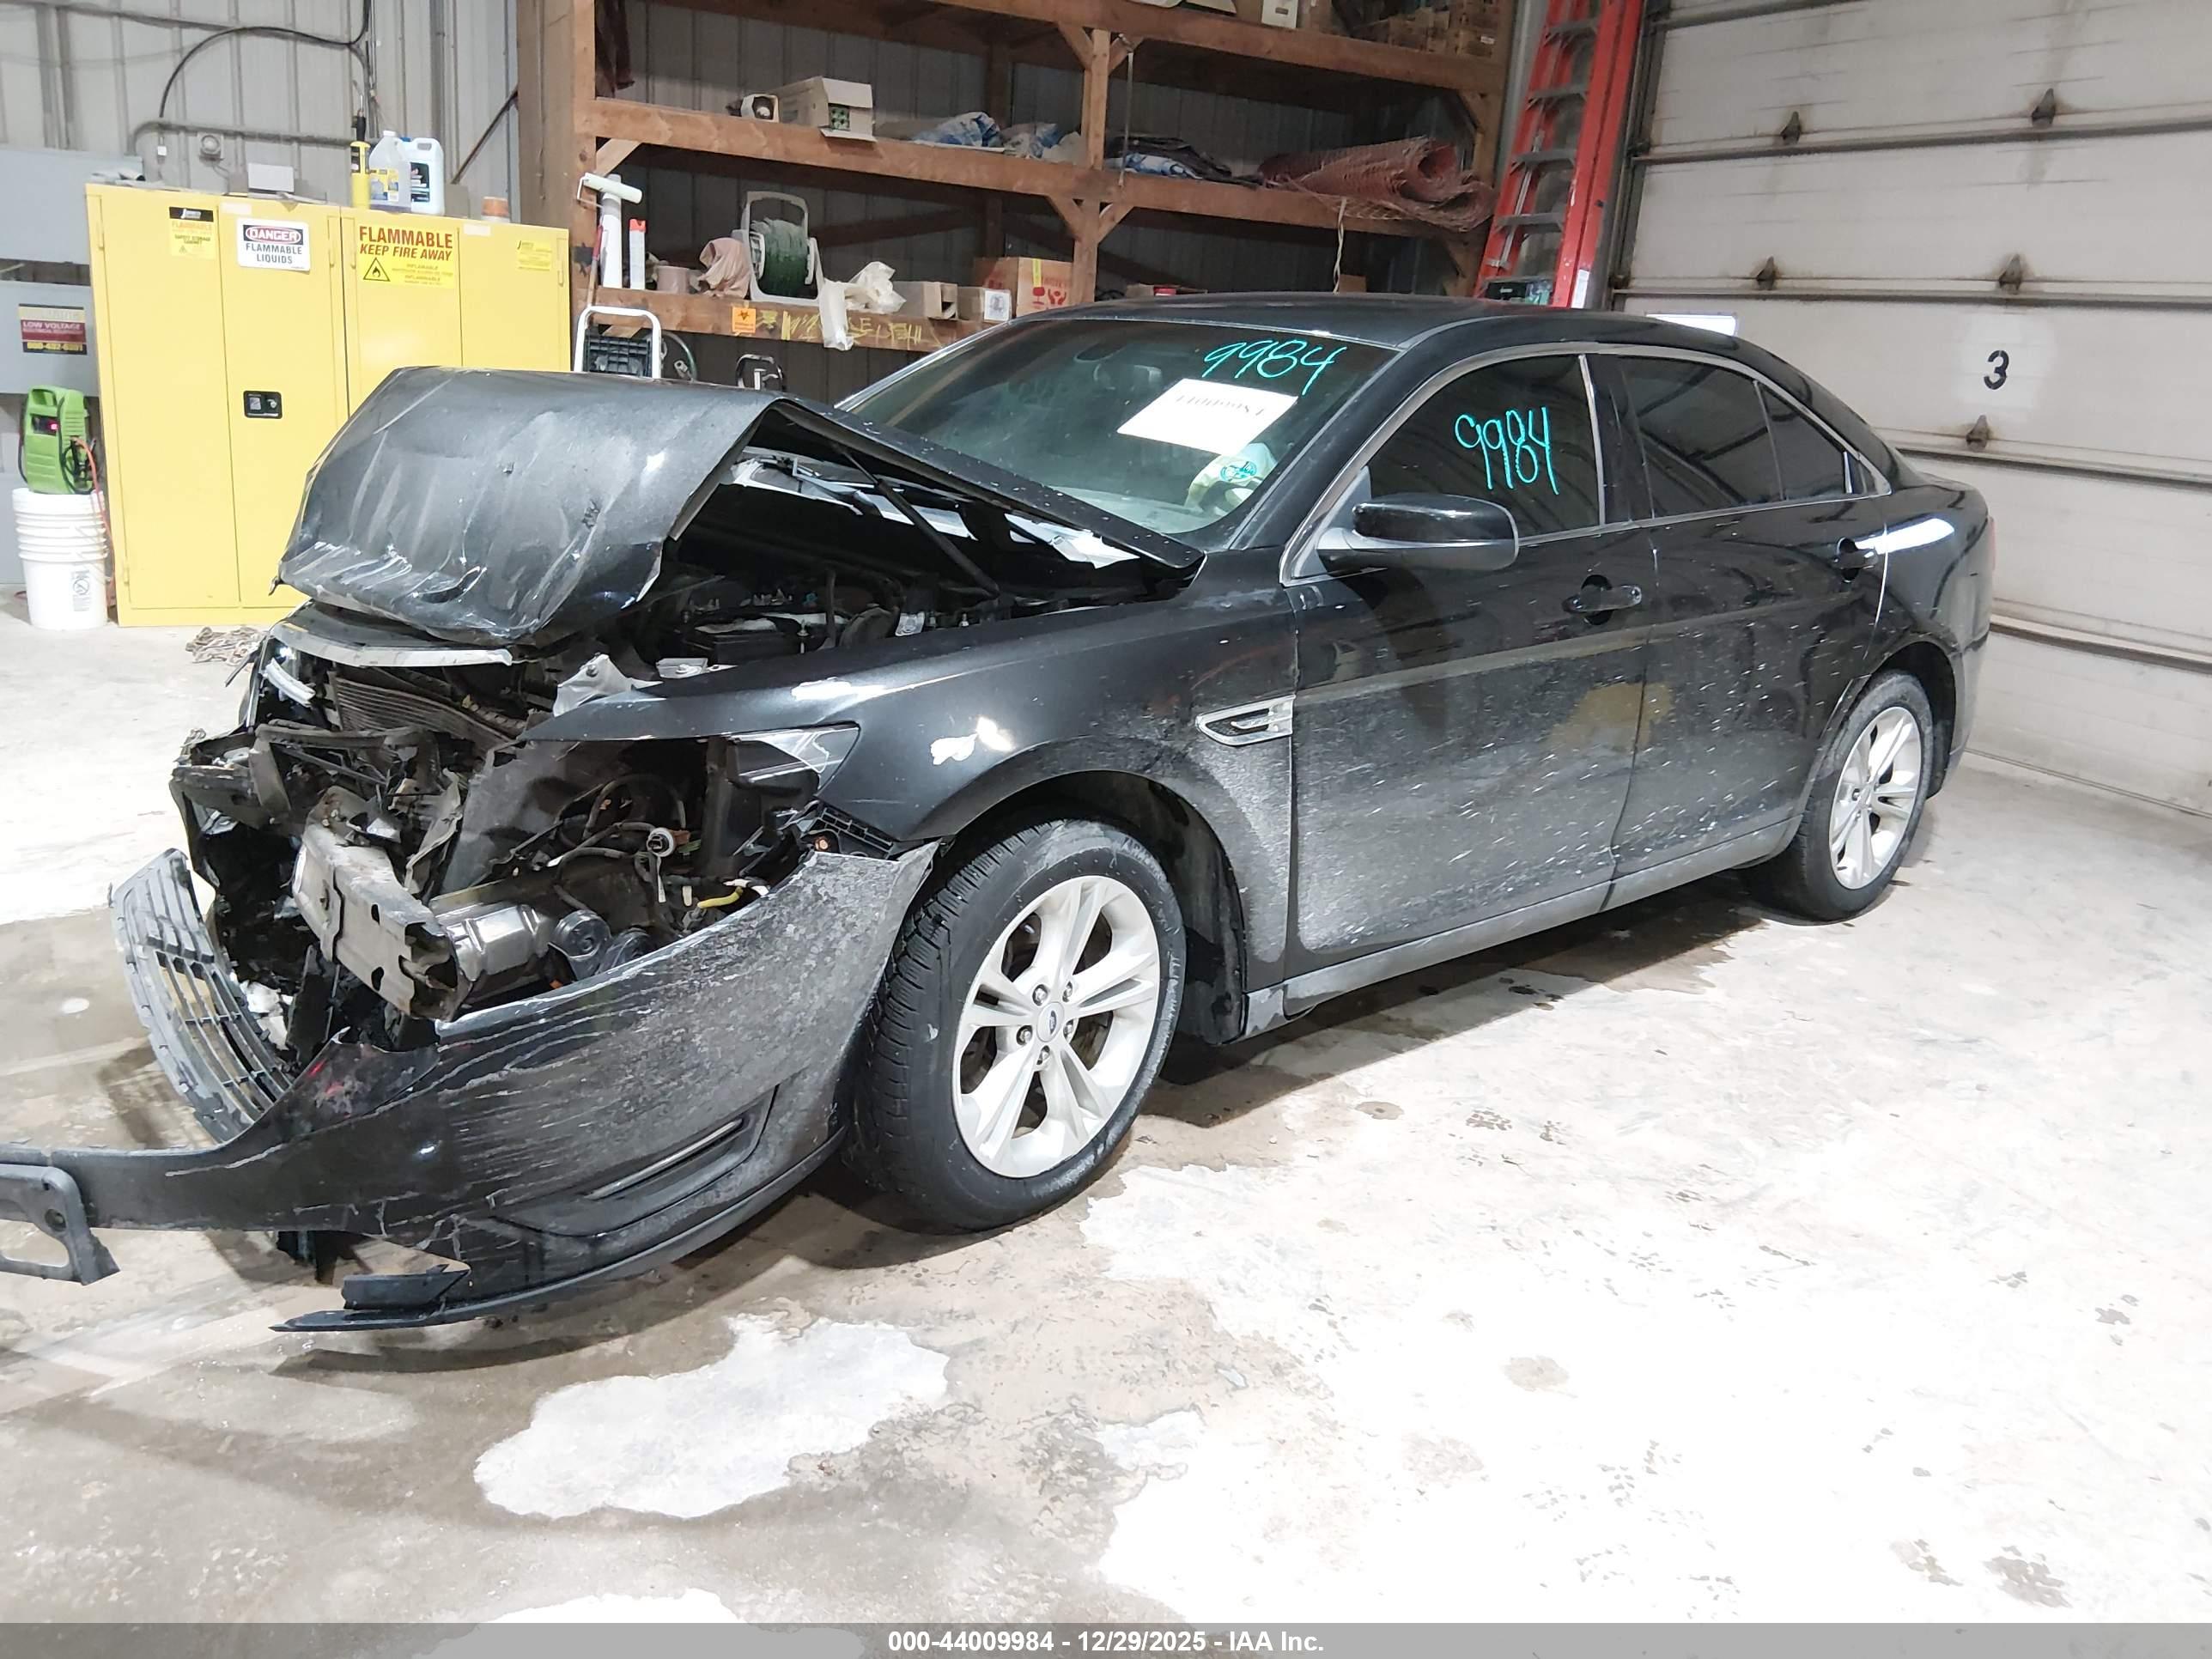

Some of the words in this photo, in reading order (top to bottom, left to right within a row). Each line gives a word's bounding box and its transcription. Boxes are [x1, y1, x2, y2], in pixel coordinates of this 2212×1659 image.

[249, 228, 297, 241] DANGER
[359, 225, 453, 249] FLAMMABLE
[246, 242, 302, 255] FLAMMABLE
[360, 243, 390, 256] KEEP
[392, 246, 418, 258] FIRE
[420, 248, 452, 261] AWAY
[257, 253, 293, 264] LIQUIDS
[22, 320, 43, 329] LOW
[44, 321, 81, 330] VOLTAGE
[1202, 339, 1348, 396] 9984
[1984, 349, 2009, 391] 3
[1455, 405, 1560, 495] 9984
